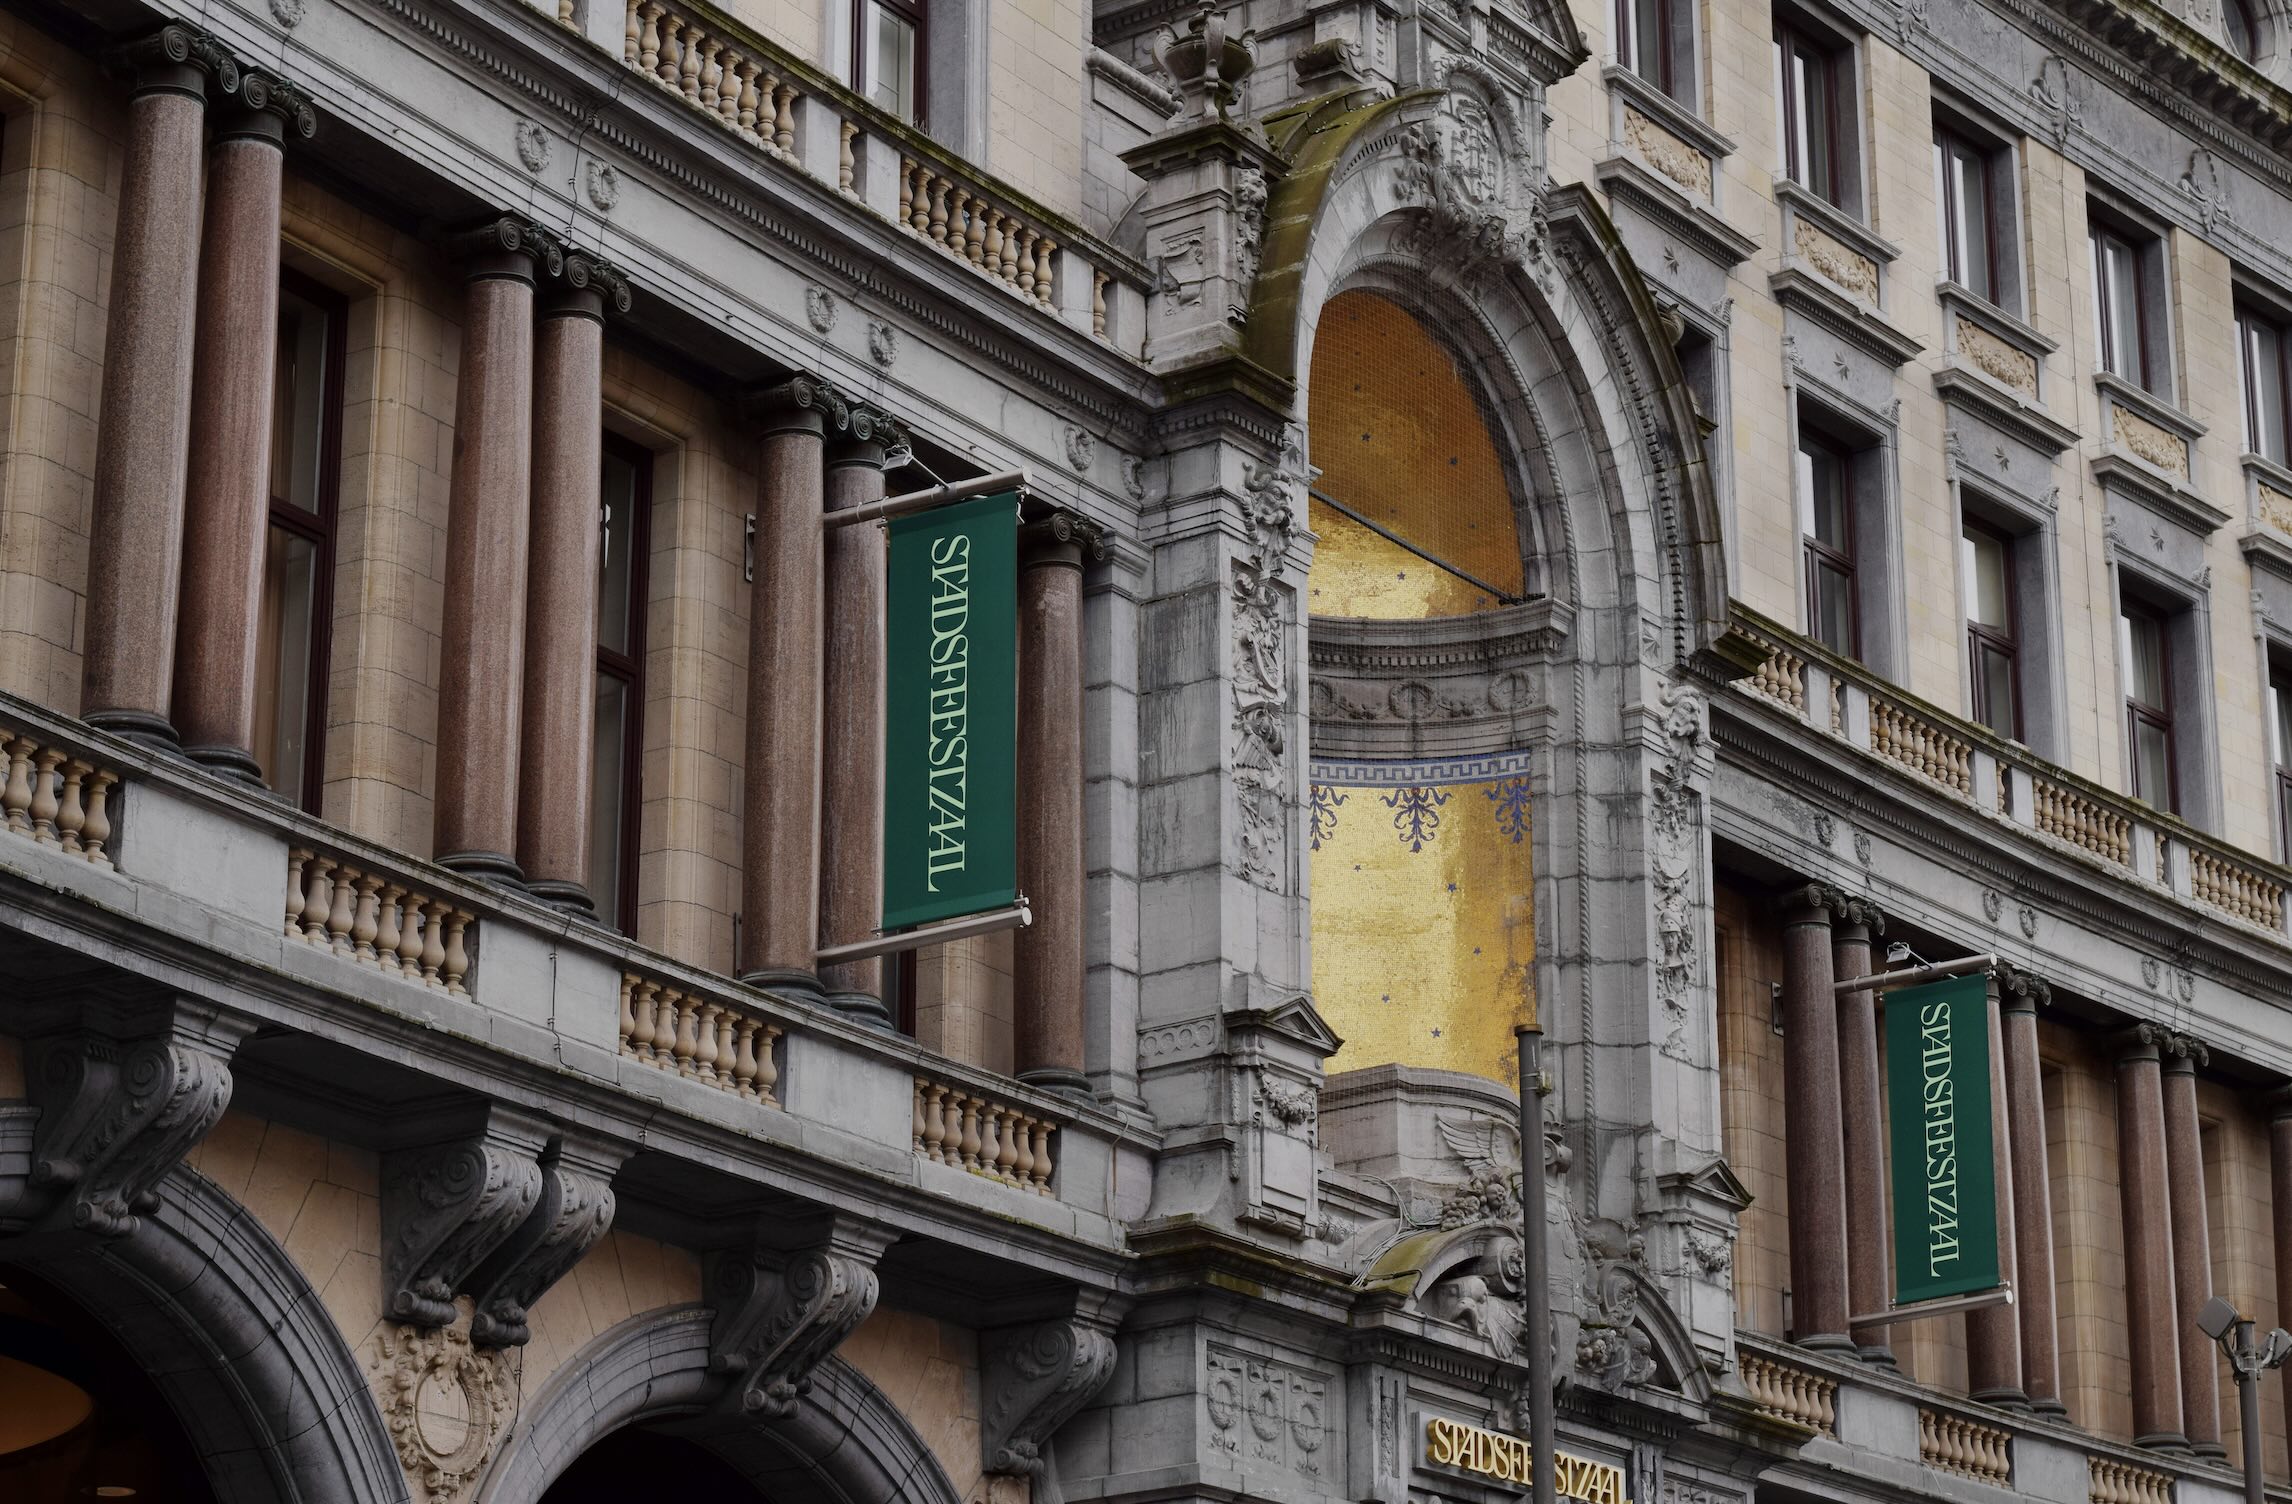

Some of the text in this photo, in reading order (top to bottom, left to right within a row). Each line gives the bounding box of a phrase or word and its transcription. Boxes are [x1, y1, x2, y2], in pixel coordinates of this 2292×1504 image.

[927, 534, 971, 893] STADSFEESTZAAL
[1920, 1002, 1960, 1277] STADSFEESTZAAL
[1428, 1418, 1633, 1504] STADSFESTZAAL
